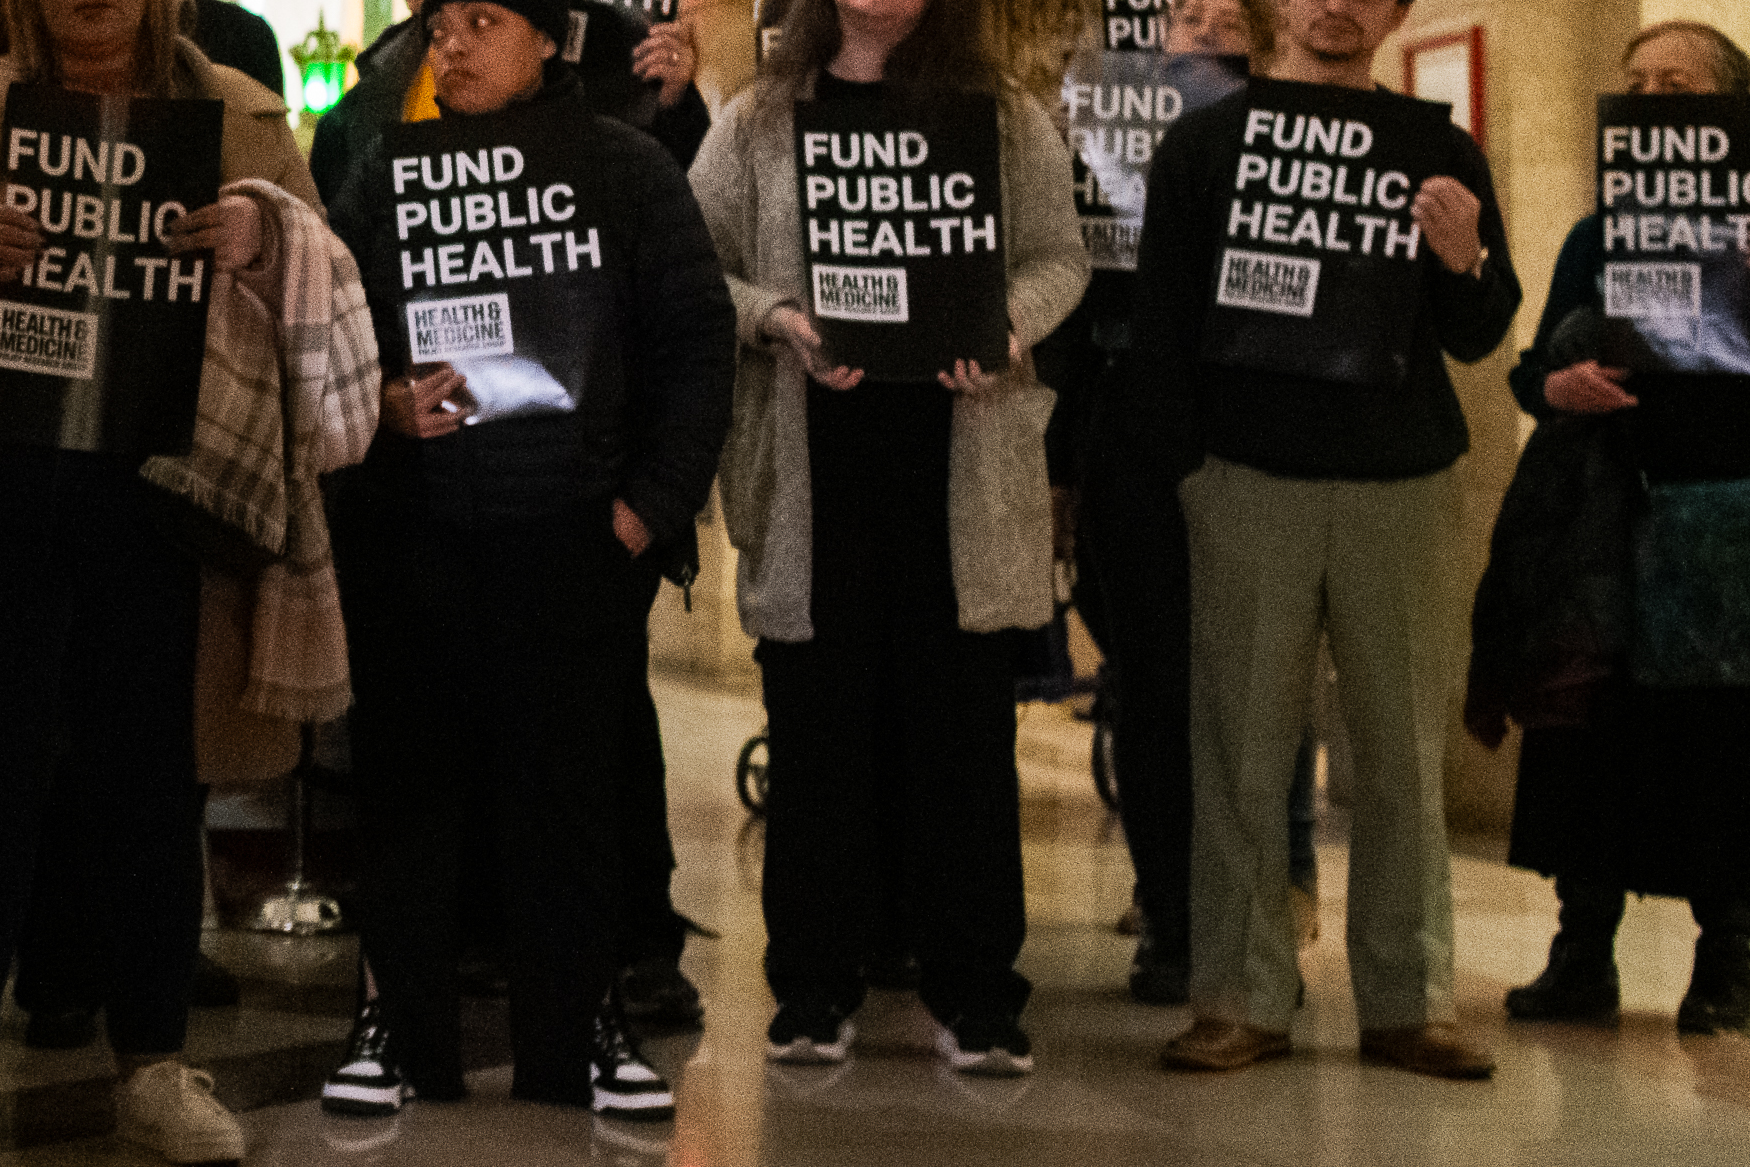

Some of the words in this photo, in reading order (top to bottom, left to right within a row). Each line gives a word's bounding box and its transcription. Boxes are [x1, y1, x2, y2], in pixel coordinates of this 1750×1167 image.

[1068, 84, 1184, 122] FUND
[804, 131, 929, 168] FUND
[1244, 108, 1374, 158] FUND
[1603, 125, 1730, 163] FUND
[8, 127, 146, 186] FUND
[393, 145, 524, 195] FUND
[806, 171, 975, 212] PUBLIC
[1236, 153, 1411, 210] PUBLIC
[1603, 169, 1750, 208] PUBLI
[396, 183, 576, 240] PUBLIC
[1227, 199, 1421, 261] HEALTH
[401, 227, 602, 290] HEALTH
[808, 214, 996, 257] HEALTH
[22, 246, 204, 303] EALTH
[2, 309, 71, 337] HEALTH
[415, 303, 484, 330] HEALTH
